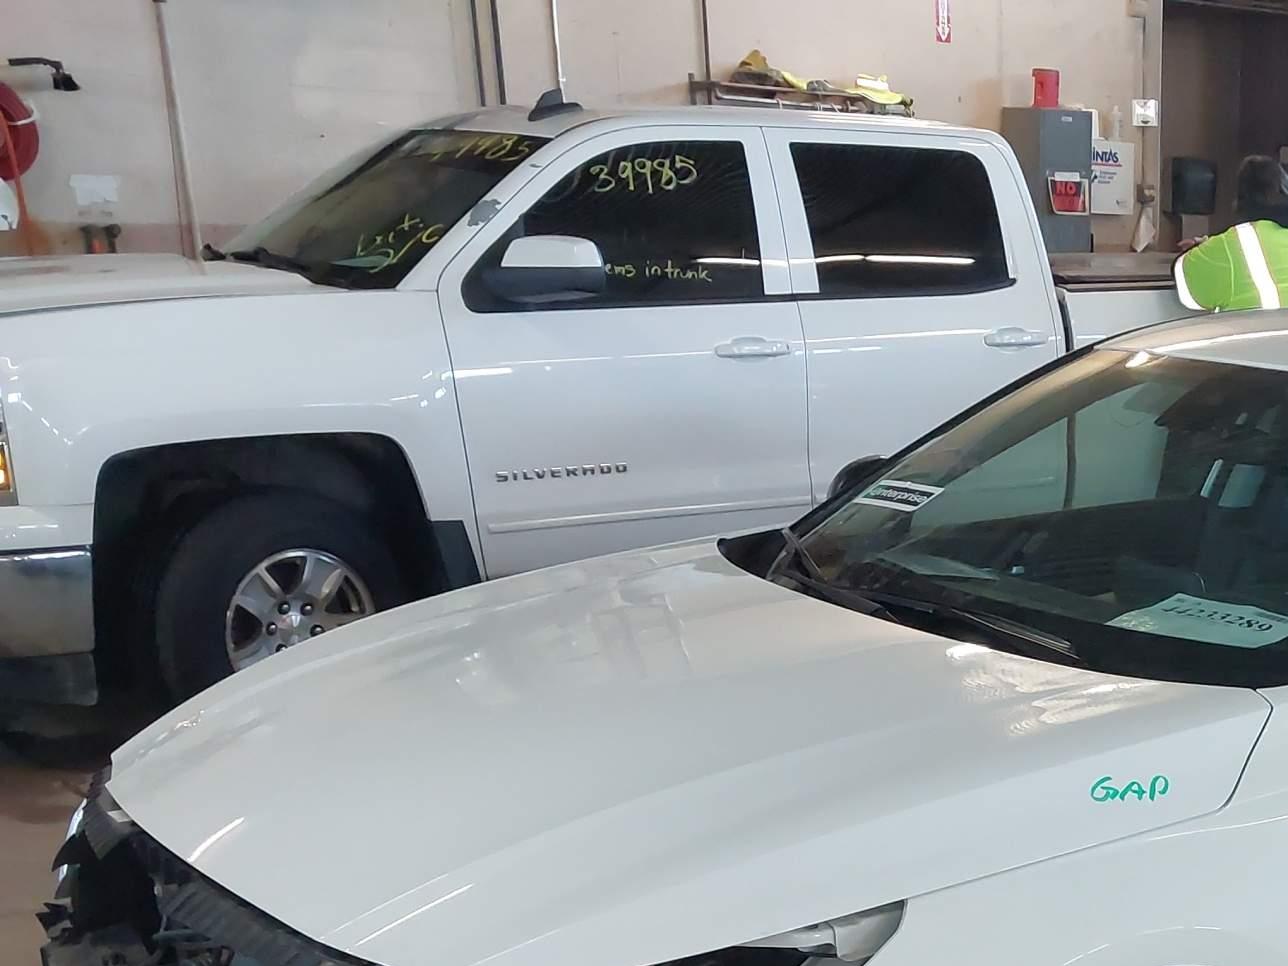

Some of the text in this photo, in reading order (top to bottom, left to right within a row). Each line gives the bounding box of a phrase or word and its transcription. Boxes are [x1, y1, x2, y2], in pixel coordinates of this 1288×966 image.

[1092, 147, 1119, 163] INTAS
[589, 154, 698, 195] 39985
[1056, 181, 1077, 195] NO
[604, 259, 713, 283] ems in trunk
[495, 461, 628, 483] SILVERADO
[870, 487, 929, 503] enterprise
[1090, 774, 1170, 802] GAP
